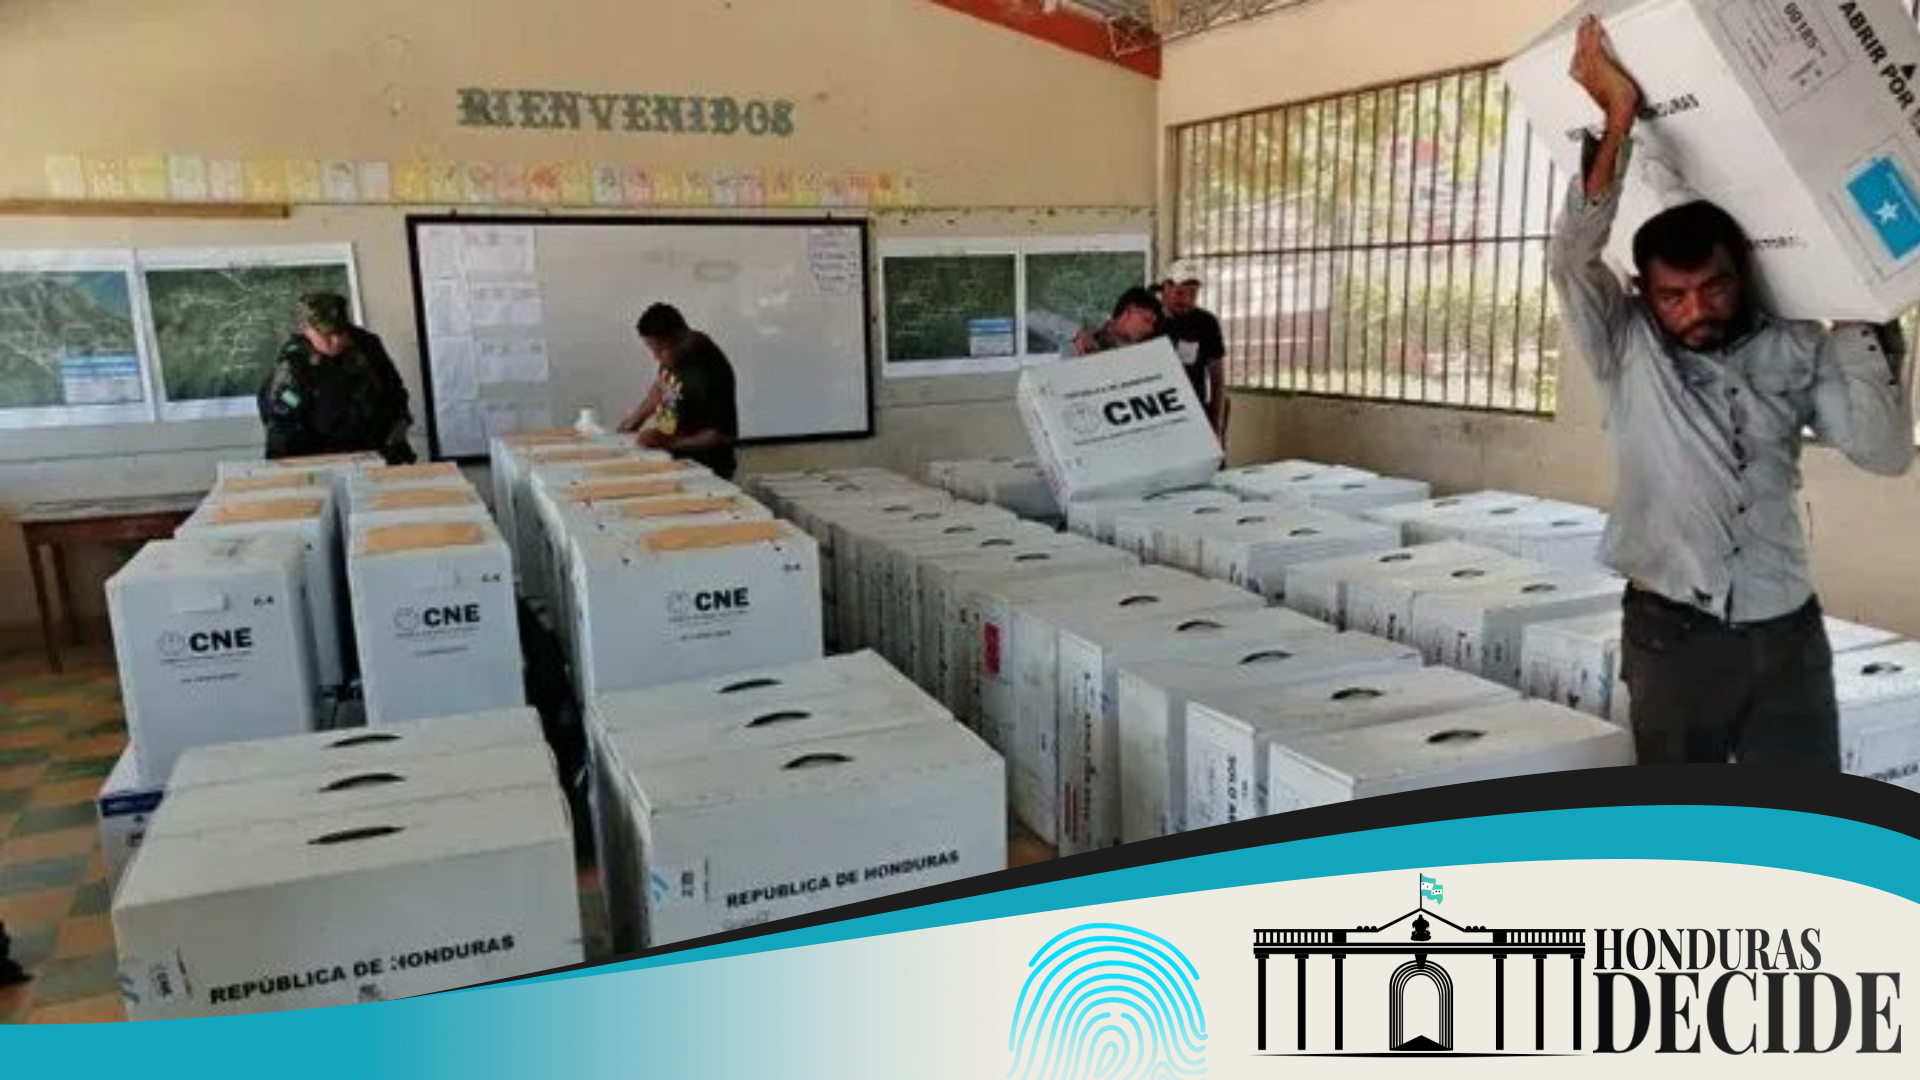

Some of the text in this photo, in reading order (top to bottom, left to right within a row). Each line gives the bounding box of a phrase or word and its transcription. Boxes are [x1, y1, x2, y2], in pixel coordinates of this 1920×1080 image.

[1839, 2, 1915, 111] ABRIR POR
[456, 86, 795, 137] BIENVENIDOS
[1103, 387, 1186, 426] CNE
[422, 603, 481, 627] CNE
[695, 587, 750, 612] CNE
[188, 626, 253, 653] CNE
[835, 870, 859, 888] DE
[864, 849, 960, 880] HONDURAS
[353, 958, 384, 978] DE
